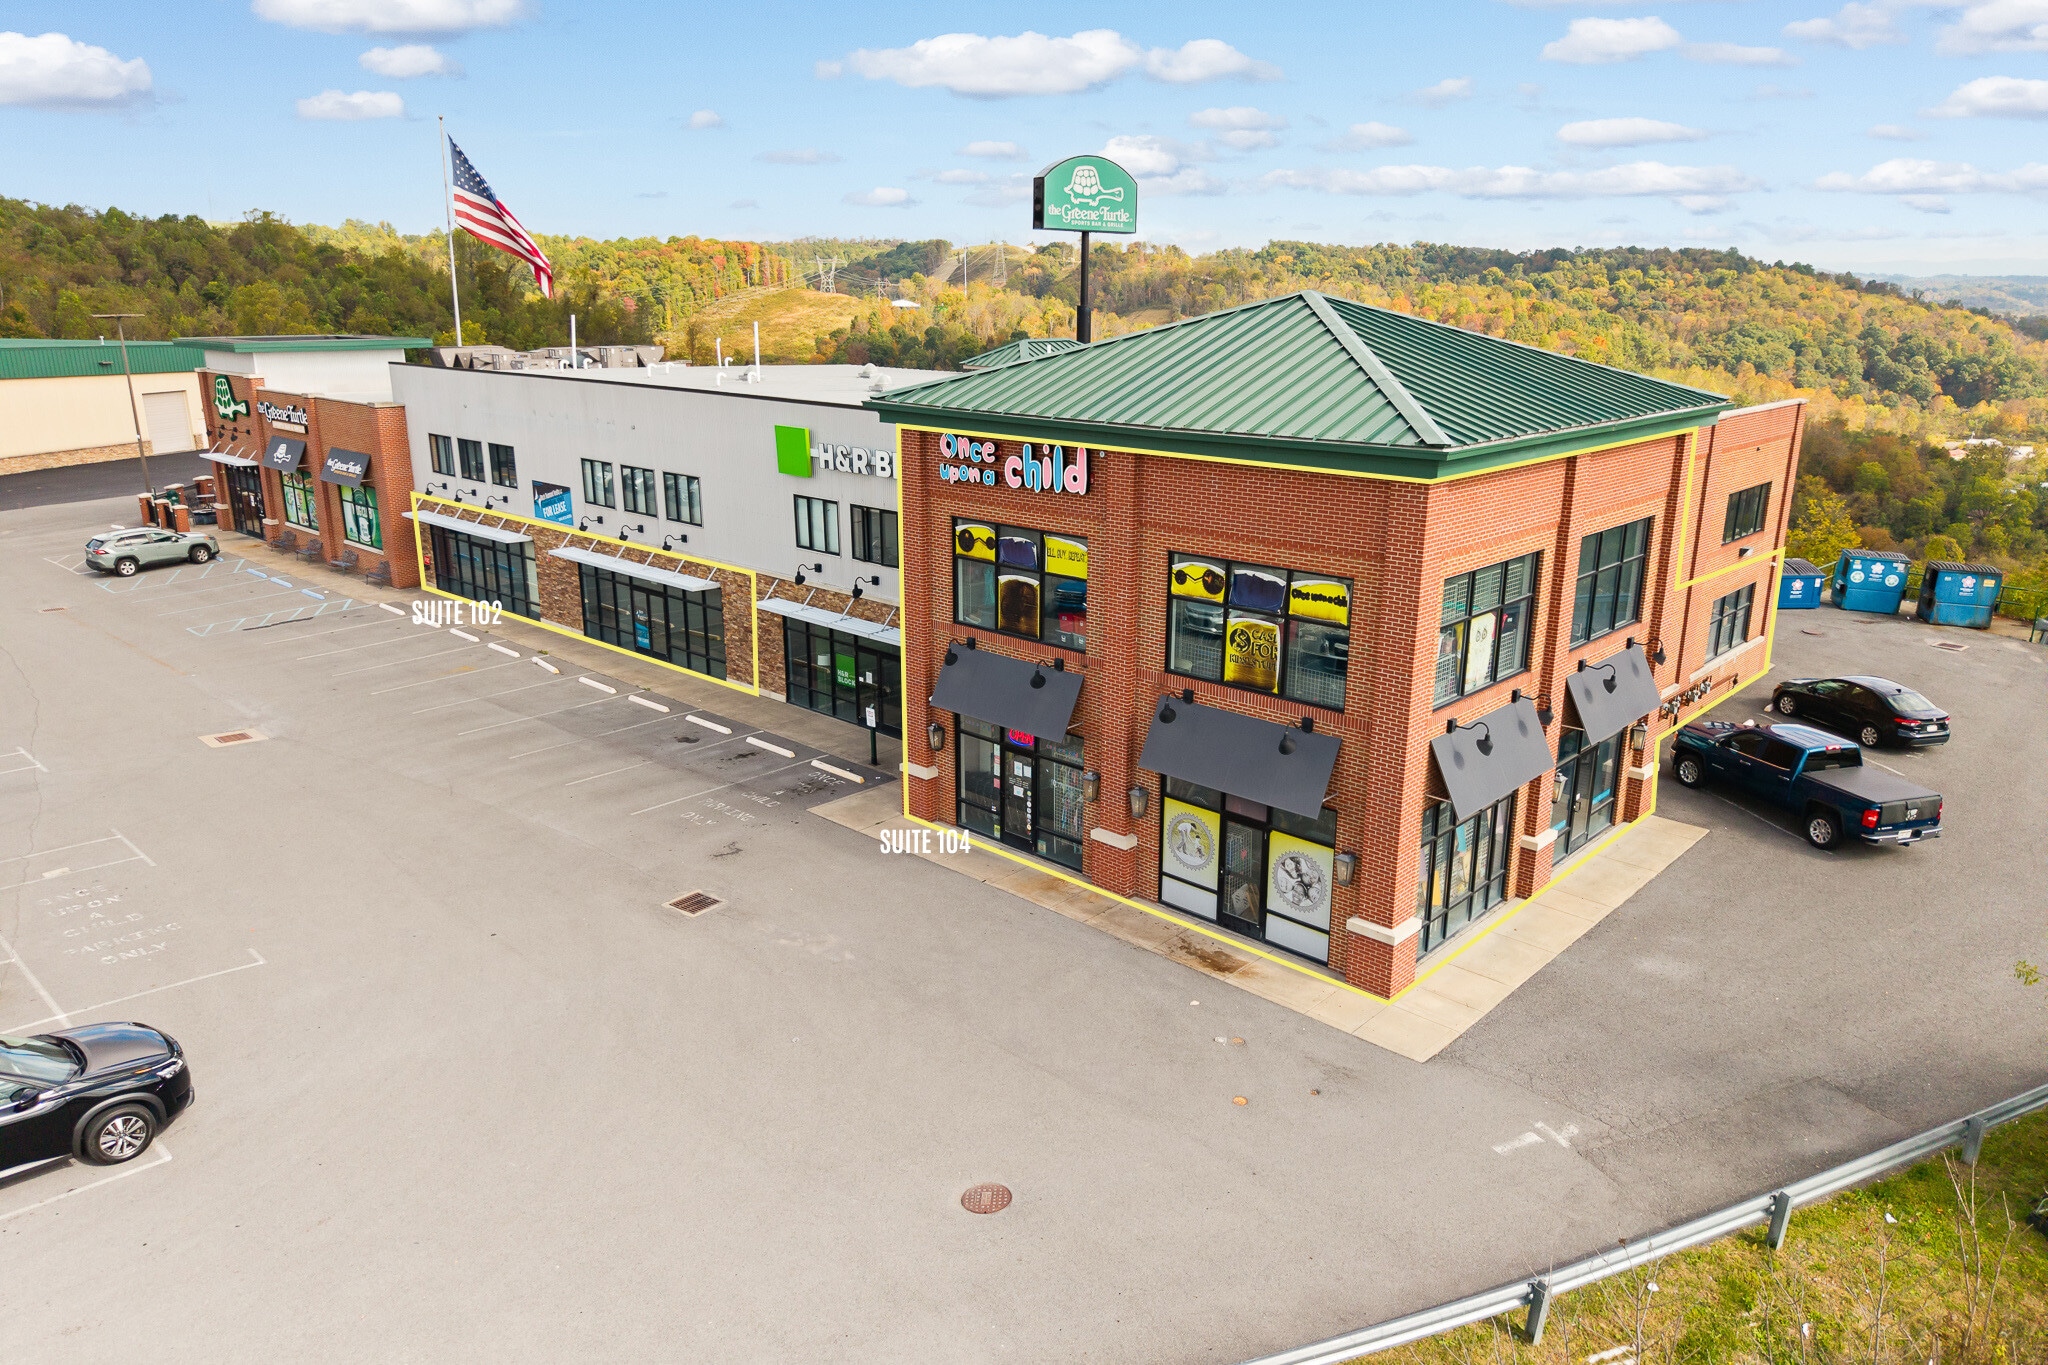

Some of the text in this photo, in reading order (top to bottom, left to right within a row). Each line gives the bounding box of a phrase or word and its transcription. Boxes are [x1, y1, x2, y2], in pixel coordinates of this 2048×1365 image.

[1048, 204, 1130, 223] the Greene Turtle
[257, 401, 308, 425] the Greene Turtle
[818, 443, 869, 475] H&R
[940, 433, 1088, 496] Once child
[939, 463, 996, 486] upon a
[542, 504, 554, 518] FOR
[552, 501, 567, 515] LEASE
[837, 669, 849, 678] H&R
[837, 675, 856, 686] BLOCK
[1008, 728, 1034, 746] OPEN
